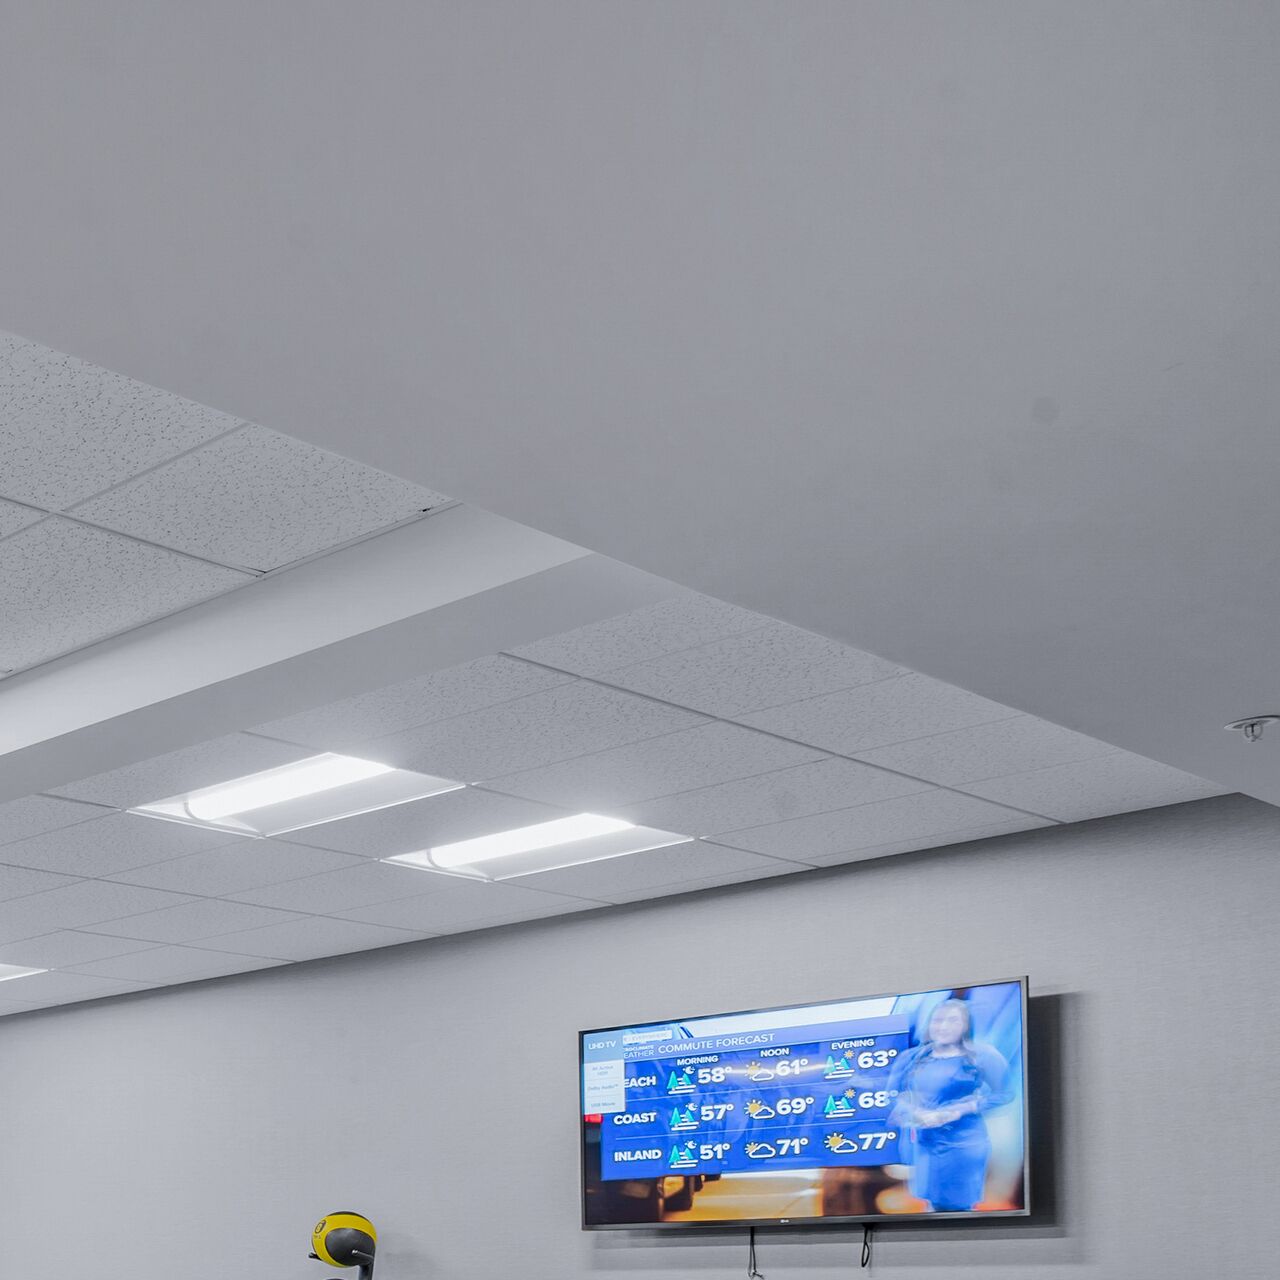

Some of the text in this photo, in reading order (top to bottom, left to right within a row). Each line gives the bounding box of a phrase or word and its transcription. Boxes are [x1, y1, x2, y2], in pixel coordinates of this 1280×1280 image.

[588, 1040, 616, 1050] UHD TV
[624, 1050, 654, 1058] EATHER
[658, 1033, 775, 1054] COMMUTE FORECAST
[677, 1038, 874, 1066] MORNING NOON EVENING
[624, 1049, 897, 1088] EACH 58° 61° 63°
[613, 1112, 657, 1125] COAST
[700, 1103, 734, 1121] 57°
[776, 1097, 814, 1115] 69°
[614, 1132, 896, 1162] INLAND 51° 71° 77°
